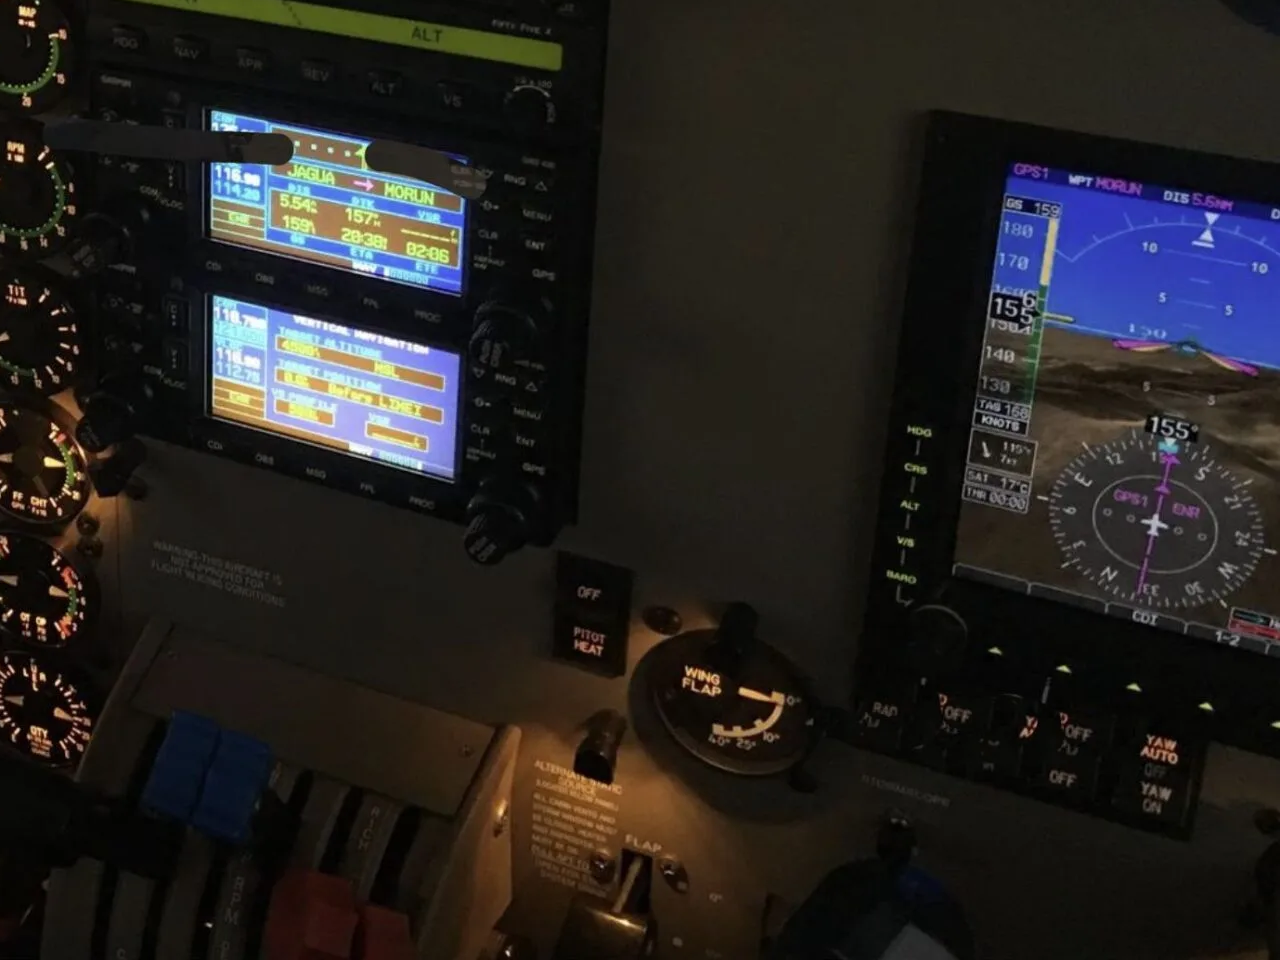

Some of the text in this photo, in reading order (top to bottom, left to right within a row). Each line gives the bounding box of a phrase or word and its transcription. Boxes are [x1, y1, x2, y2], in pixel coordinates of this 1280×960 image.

[411, 28, 443, 44] ALT
[6, 140, 25, 155] RPM
[288, 165, 435, 207] JAGUA MORUN
[1013, 162, 1050, 180] GPS1
[1068, 173, 1093, 188] WPT
[1163, 189, 1191, 205] DIS
[1006, 198, 1023, 211] GS
[1002, 220, 1034, 239] 180
[406, 242, 450, 264] 02:06
[1141, 241, 1159, 254] 10
[997, 251, 1030, 272] 170
[1250, 260, 1269, 275] 10
[7, 283, 26, 298] TIT
[293, 314, 351, 337] VERTICAL
[984, 344, 1016, 364] 140
[980, 375, 1012, 394] 130
[907, 424, 933, 438] HDG
[981, 414, 1021, 432] KNOTS
[1104, 451, 1125, 466] 12
[903, 462, 929, 476] CRS
[30, 495, 48, 509] CHT
[899, 499, 921, 512] ALT
[989, 491, 1027, 510] 00:00
[1113, 487, 1149, 508] GPS1
[1172, 501, 1201, 520] ENR
[885, 569, 918, 585] BARO
[576, 585, 602, 601] OFF
[1131, 609, 1160, 627] CDI
[573, 625, 607, 645] PITOT
[573, 640, 605, 657] HEAT
[684, 665, 721, 686] WING
[681, 677, 722, 698] FLAP
[944, 705, 972, 724] OFF
[1065, 724, 1094, 742] OFF
[1146, 733, 1178, 752] YAW
[1140, 747, 1179, 765] AUTO
[1048, 769, 1078, 788] OFF
[1141, 781, 1173, 802] YAW
[1142, 799, 1163, 816] ON
[625, 834, 663, 852] FLAP
